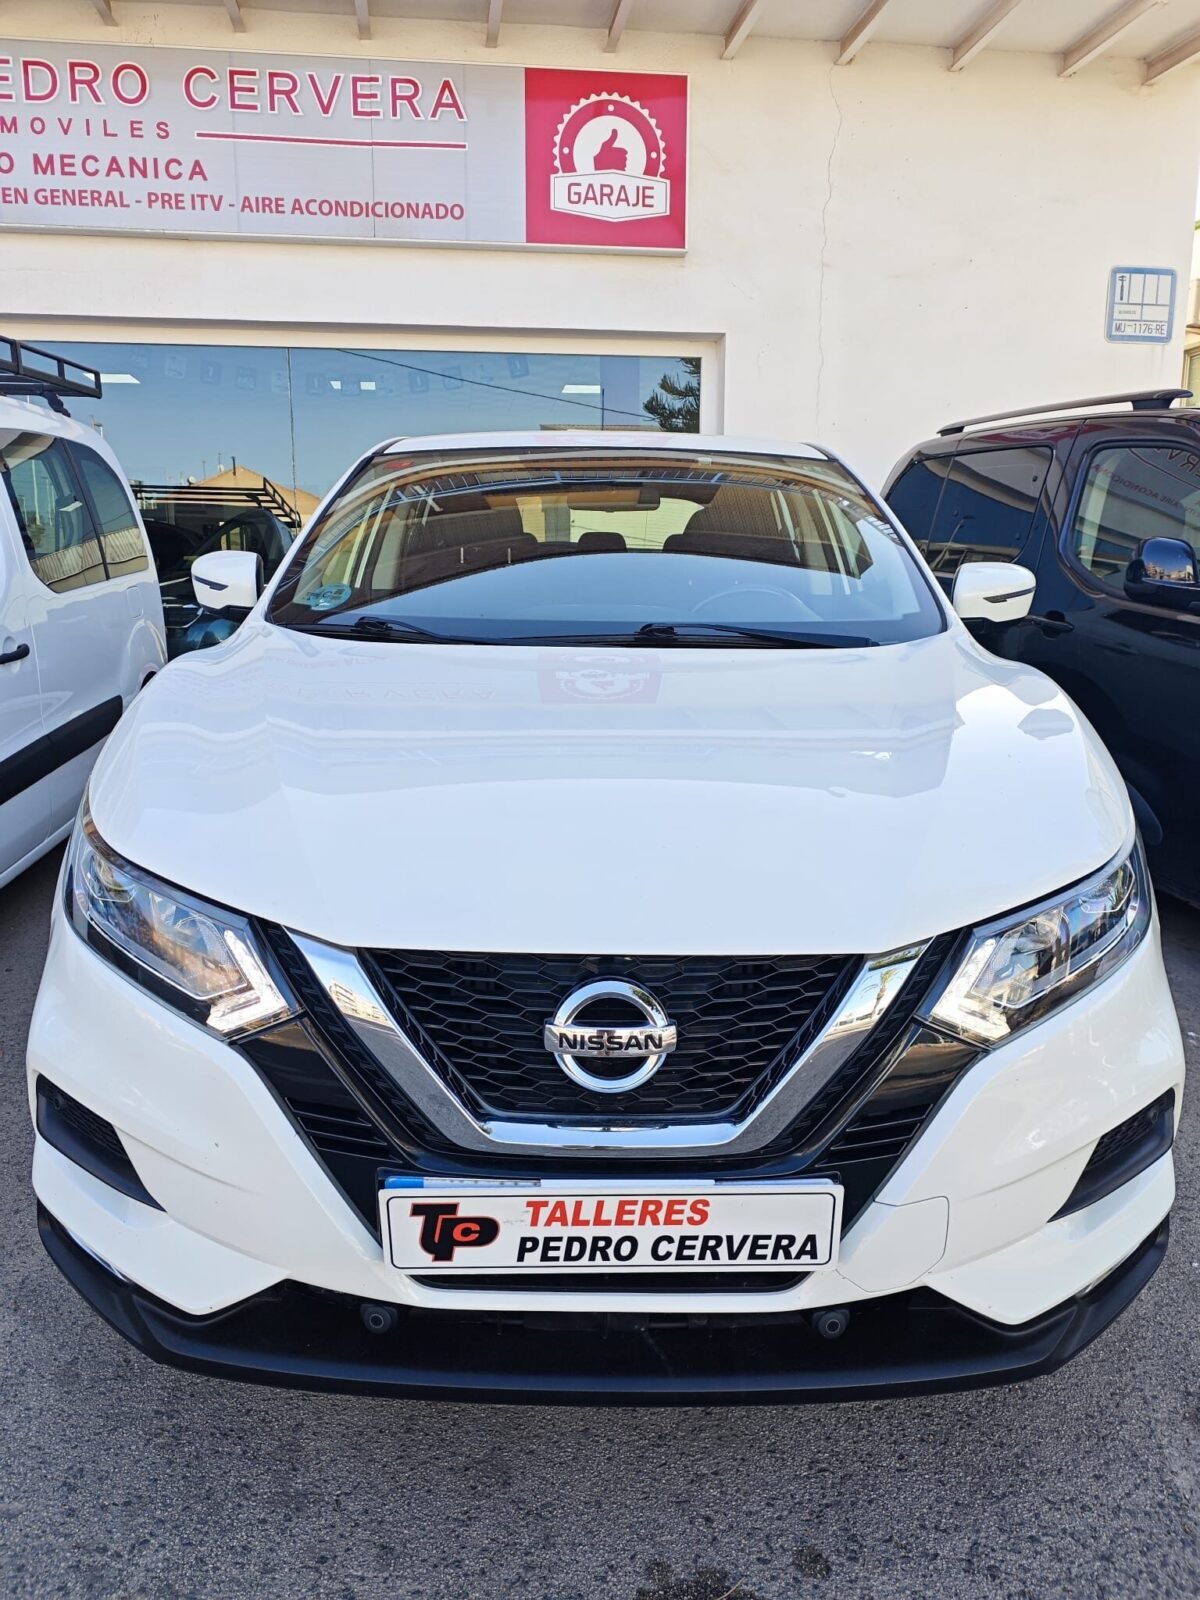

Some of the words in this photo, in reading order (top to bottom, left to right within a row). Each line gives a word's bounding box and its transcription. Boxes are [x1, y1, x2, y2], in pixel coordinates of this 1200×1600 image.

[183, 66, 466, 119] CERVERA
[0, 115, 170, 140] MOVILES
[32, 153, 208, 181] MECANICA
[1, 187, 29, 205] EN
[34, 188, 130, 208] GENERAL
[147, 192, 186, 210] PRE
[190, 193, 223, 211] ITV
[240, 196, 286, 214] AIRE
[290, 198, 465, 220] ACONDICIONADO
[567, 182, 655, 208] GARAJE
[558, 1031, 663, 1051] NISSAN
[525, 1199, 710, 1227] TALLERES
[516, 1235, 639, 1263] PEDRO
[650, 1234, 819, 1261] CERVERA
